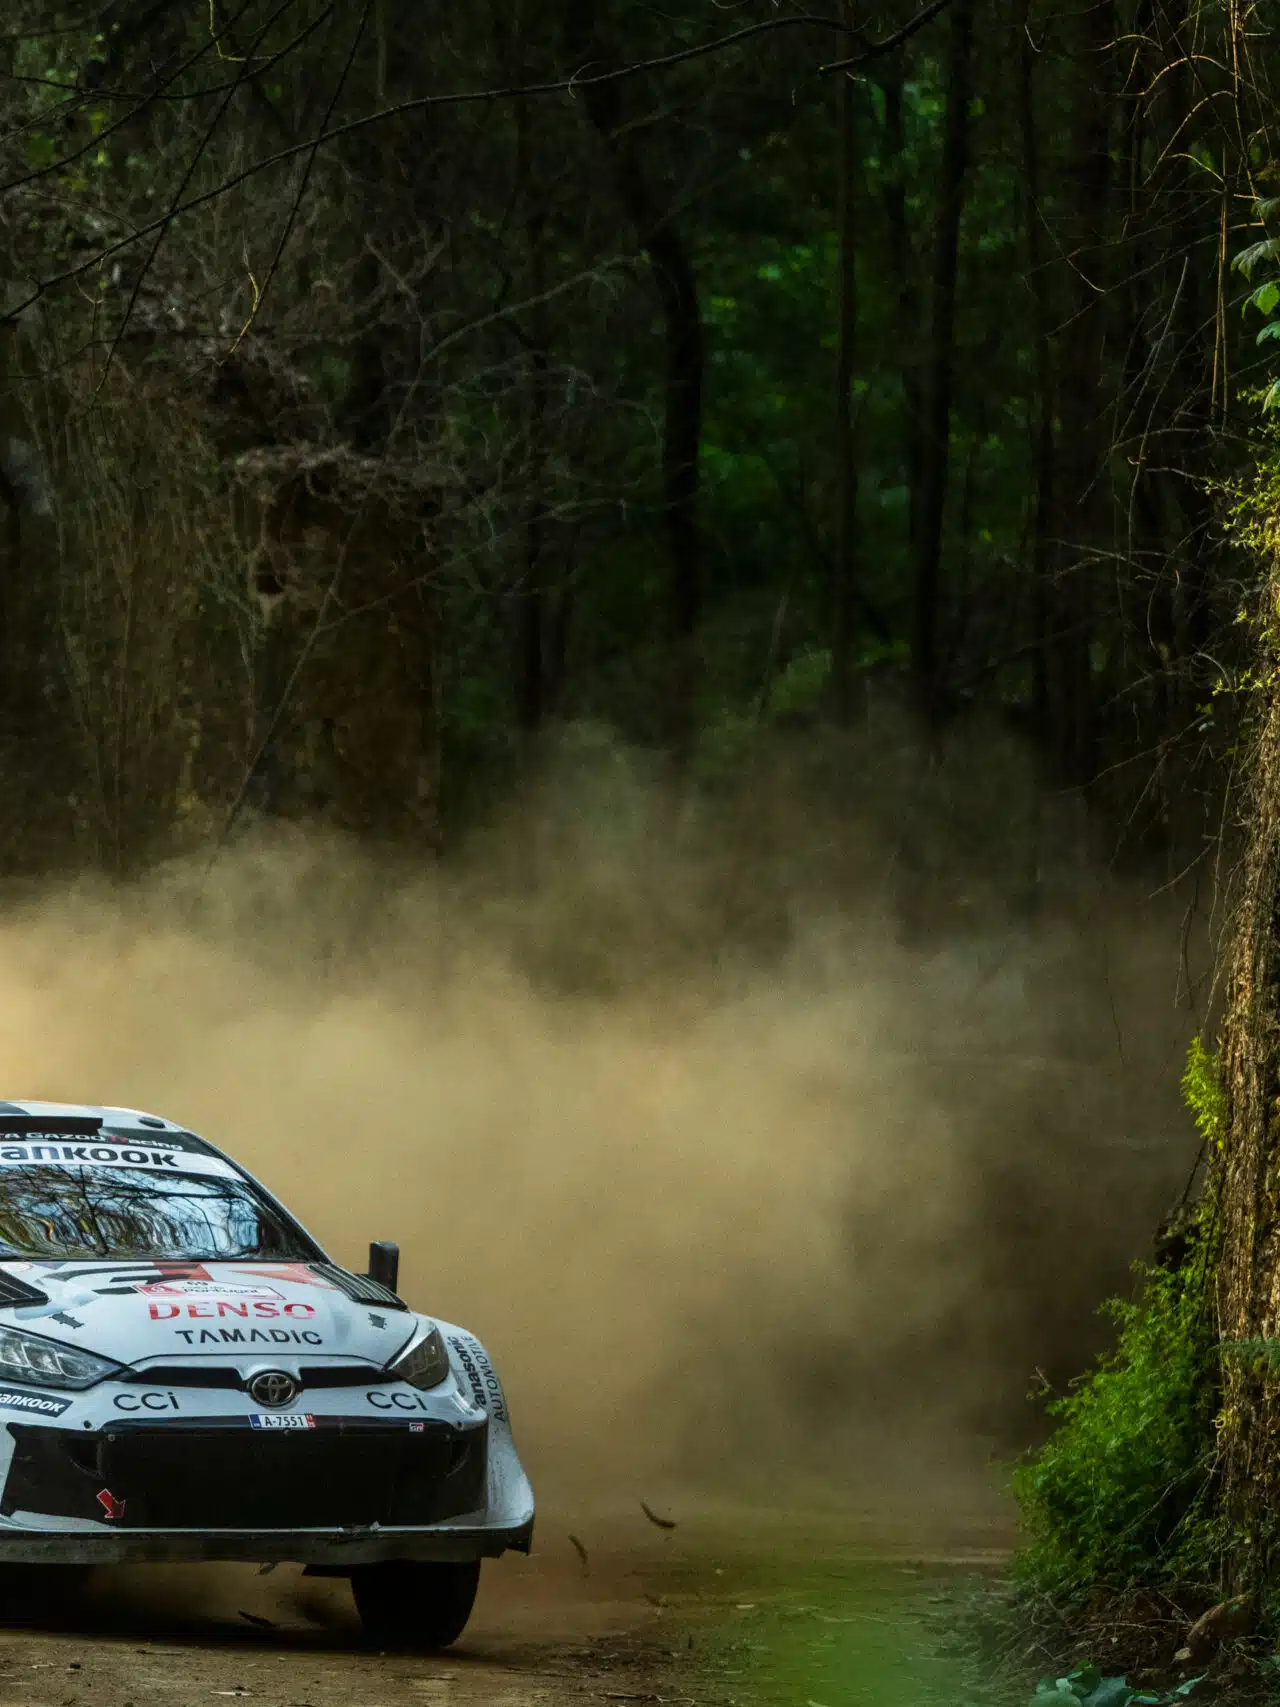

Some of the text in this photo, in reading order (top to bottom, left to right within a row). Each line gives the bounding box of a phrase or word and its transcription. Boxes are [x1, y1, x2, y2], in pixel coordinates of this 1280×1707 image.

[26, 1132, 107, 1142] GAZOO
[149, 1302, 316, 1320] DENSO
[175, 1329, 323, 1346] TAMADIC
[265, 1415, 305, 1427] A-7551
